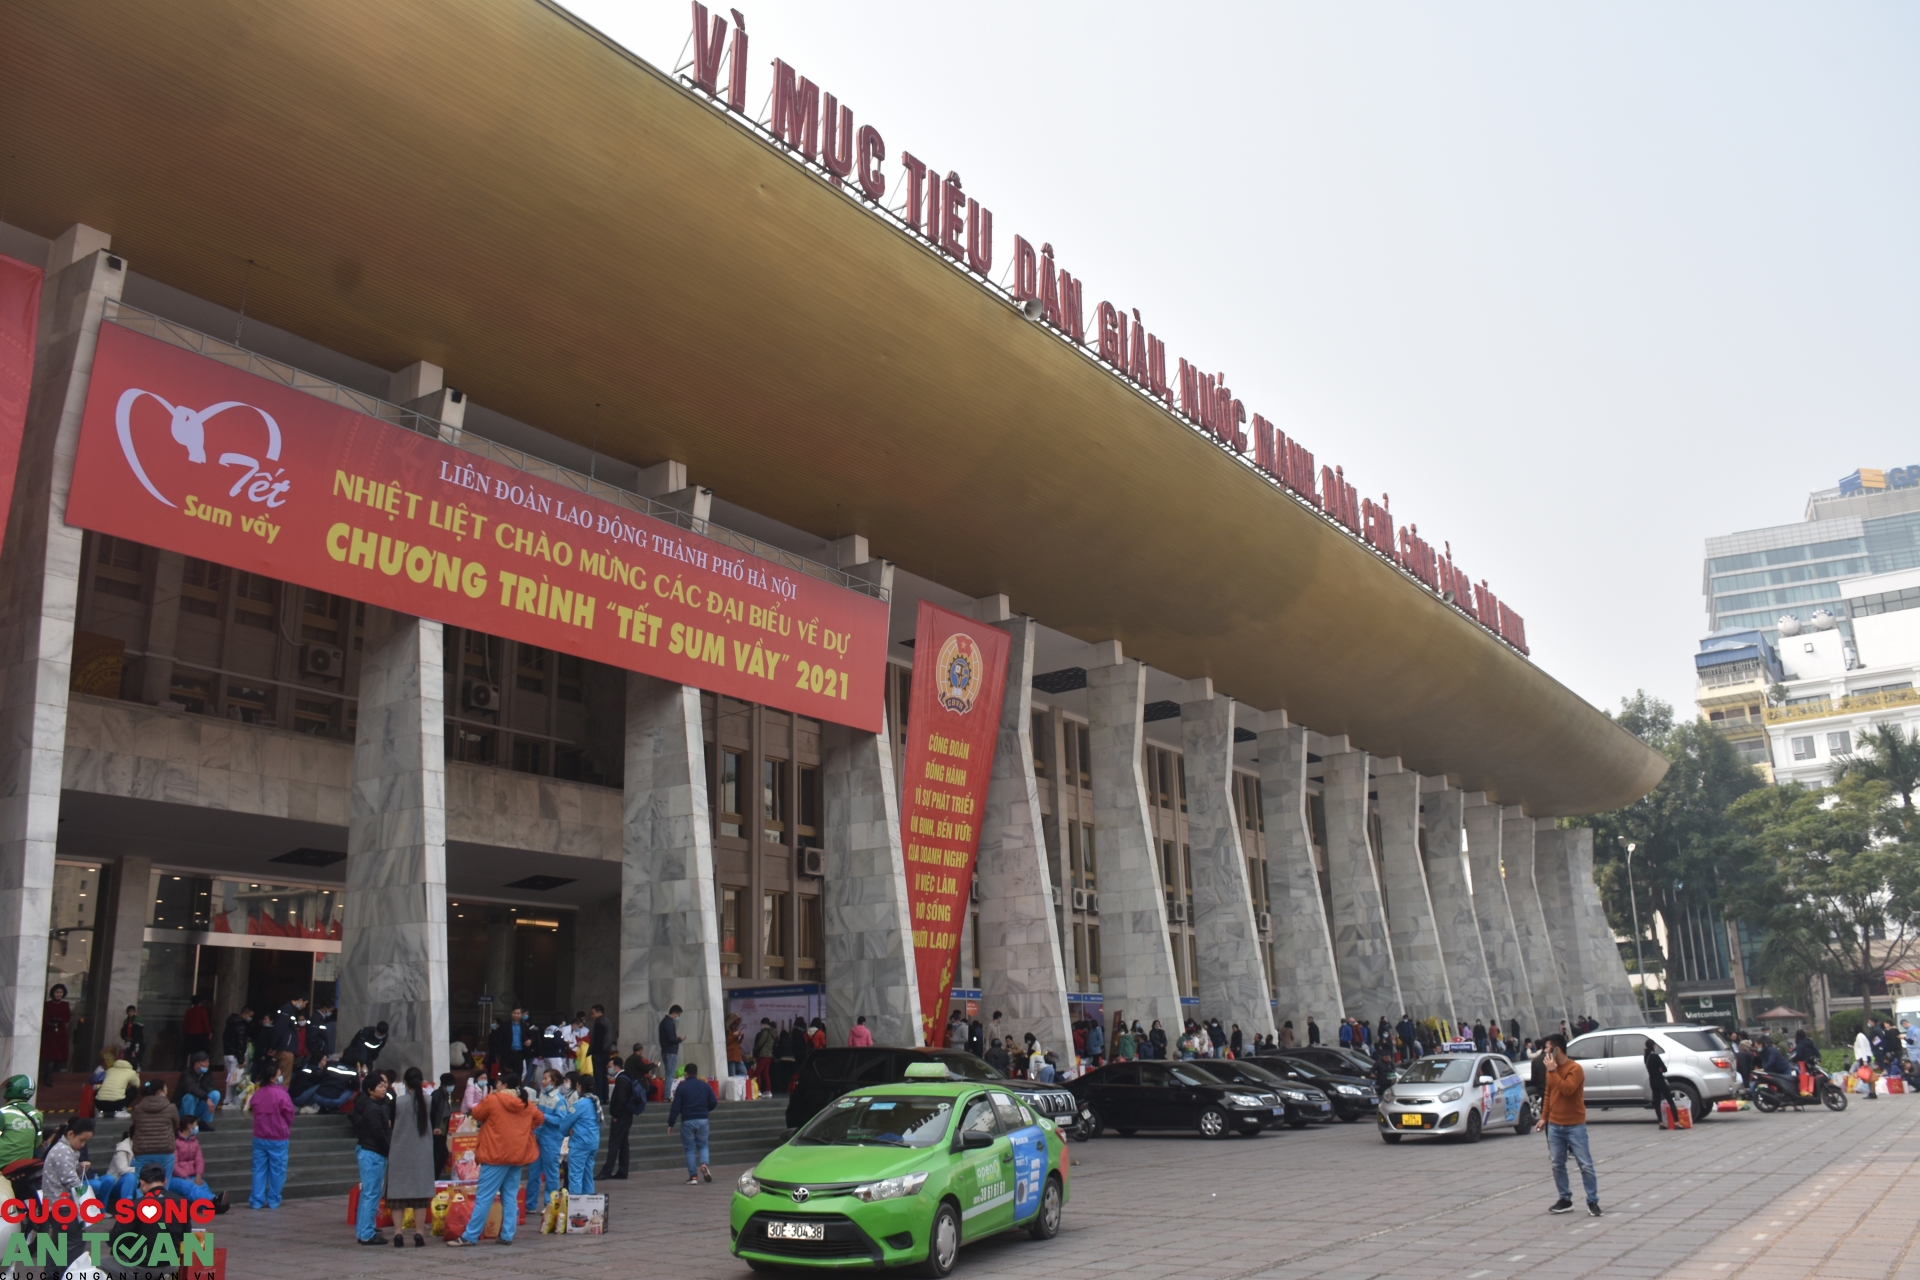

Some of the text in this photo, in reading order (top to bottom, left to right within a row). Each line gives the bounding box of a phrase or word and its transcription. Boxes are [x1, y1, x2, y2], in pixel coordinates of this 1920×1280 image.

[692, 0, 749, 114] VÌ
[771, 57, 886, 200] MỤC
[902, 151, 993, 276] TIÊU
[1014, 234, 1085, 346] DÂN
[1098, 301, 1174, 411] GIÀU,
[218, 452, 290, 508] Tết
[184, 494, 281, 544] Sum vầy
[439, 460, 797, 601] LIÊN ĐOÀN LAO ĐỘNG THÀNH PHỐ HÀ NỘI
[332, 469, 851, 660] NHIỆT LIỆT CHÀO MỪNG CÁC ĐẠI BIỂU VỀ DỰ
[326, 522, 488, 599] CHƯƠNG
[498, 570, 596, 630] TRÌNH
[668, 622, 725, 667] SUM
[795, 660, 849, 701] 2021
[928, 732, 970, 760] CÔNG ĐOÀN
[945, 764, 967, 787] HÀNH
[931, 790, 951, 811] PHÁT
[936, 873, 958, 897] LÀM,
[926, 898, 951, 922] SỐNG
[930, 931, 949, 950] LAO
[1685, 1009, 1732, 1019] Vietcombank
